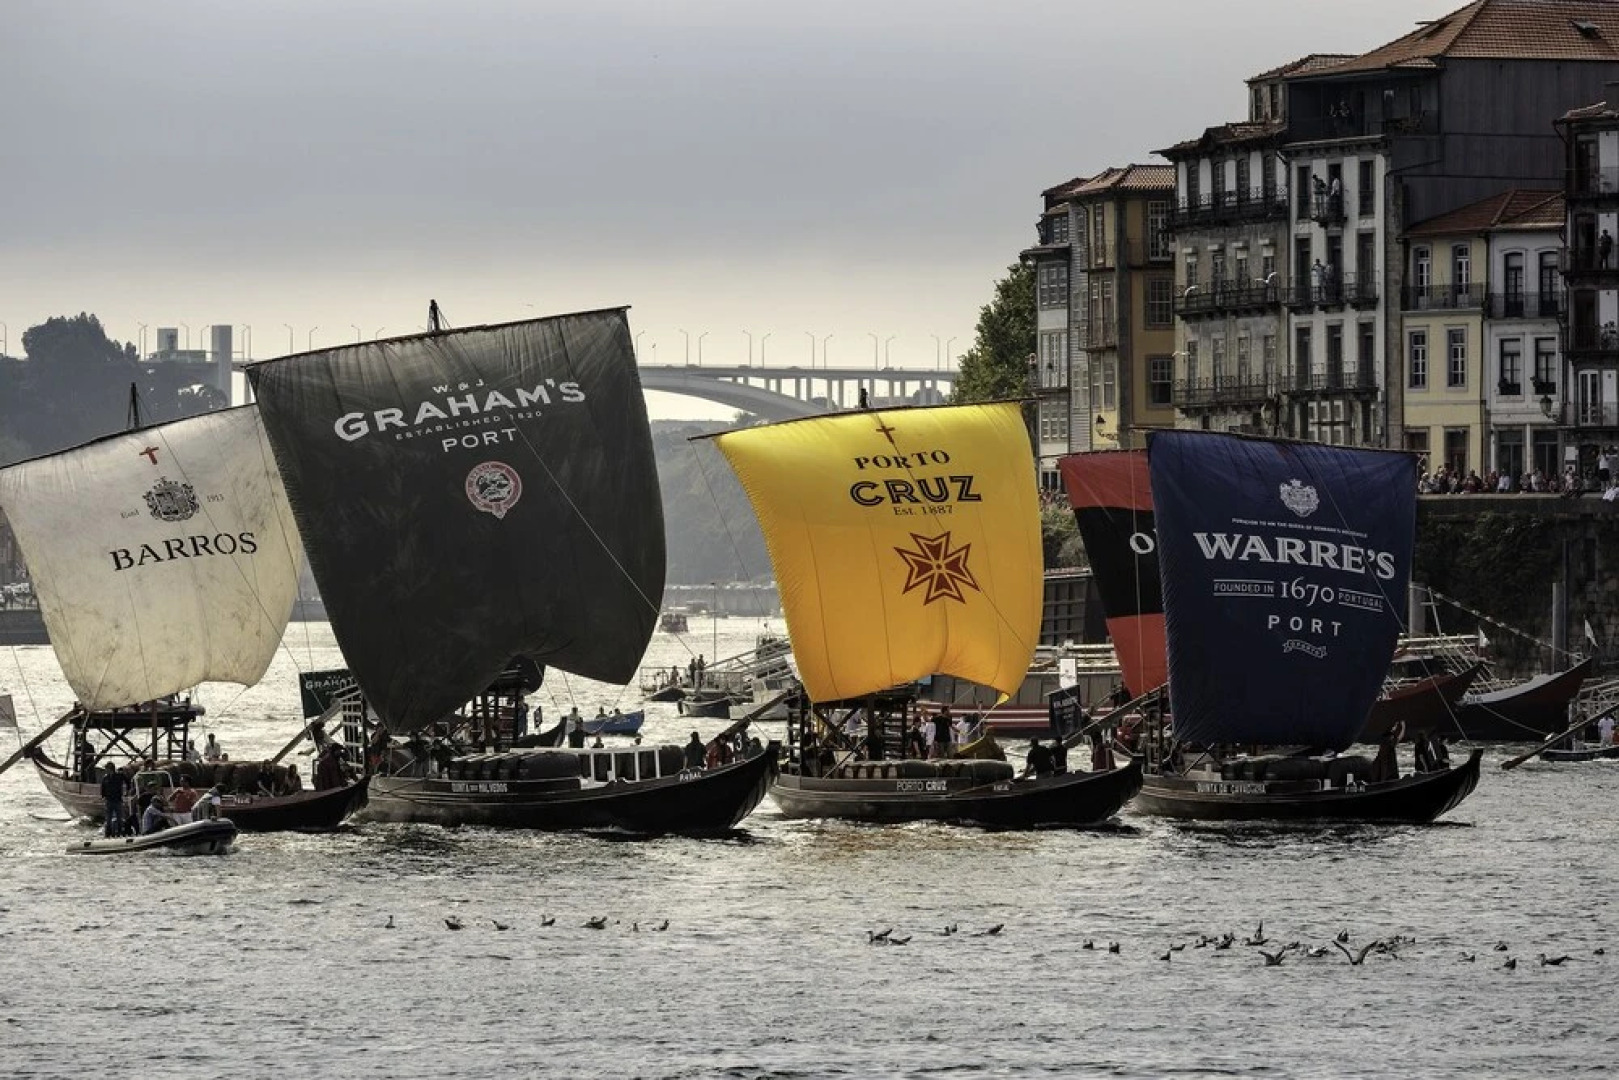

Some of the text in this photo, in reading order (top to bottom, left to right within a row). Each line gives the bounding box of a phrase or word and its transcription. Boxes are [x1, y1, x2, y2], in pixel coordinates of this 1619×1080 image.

[334, 379, 586, 441] GRAHAM'S
[395, 416, 501, 441] ESTABLISHED
[441, 428, 517, 453] PORT
[854, 449, 951, 470] PORTO
[850, 475, 983, 507] CRUZ
[921, 504, 953, 515] 1887
[109, 531, 258, 572] BARROS
[1193, 532, 1396, 581] WARRE'S
[1213, 576, 1384, 609] FOUNDED IN 1670 PORTUGAL
[1267, 614, 1343, 638] PORT
[896, 781, 948, 792] PORTO CRUZ
